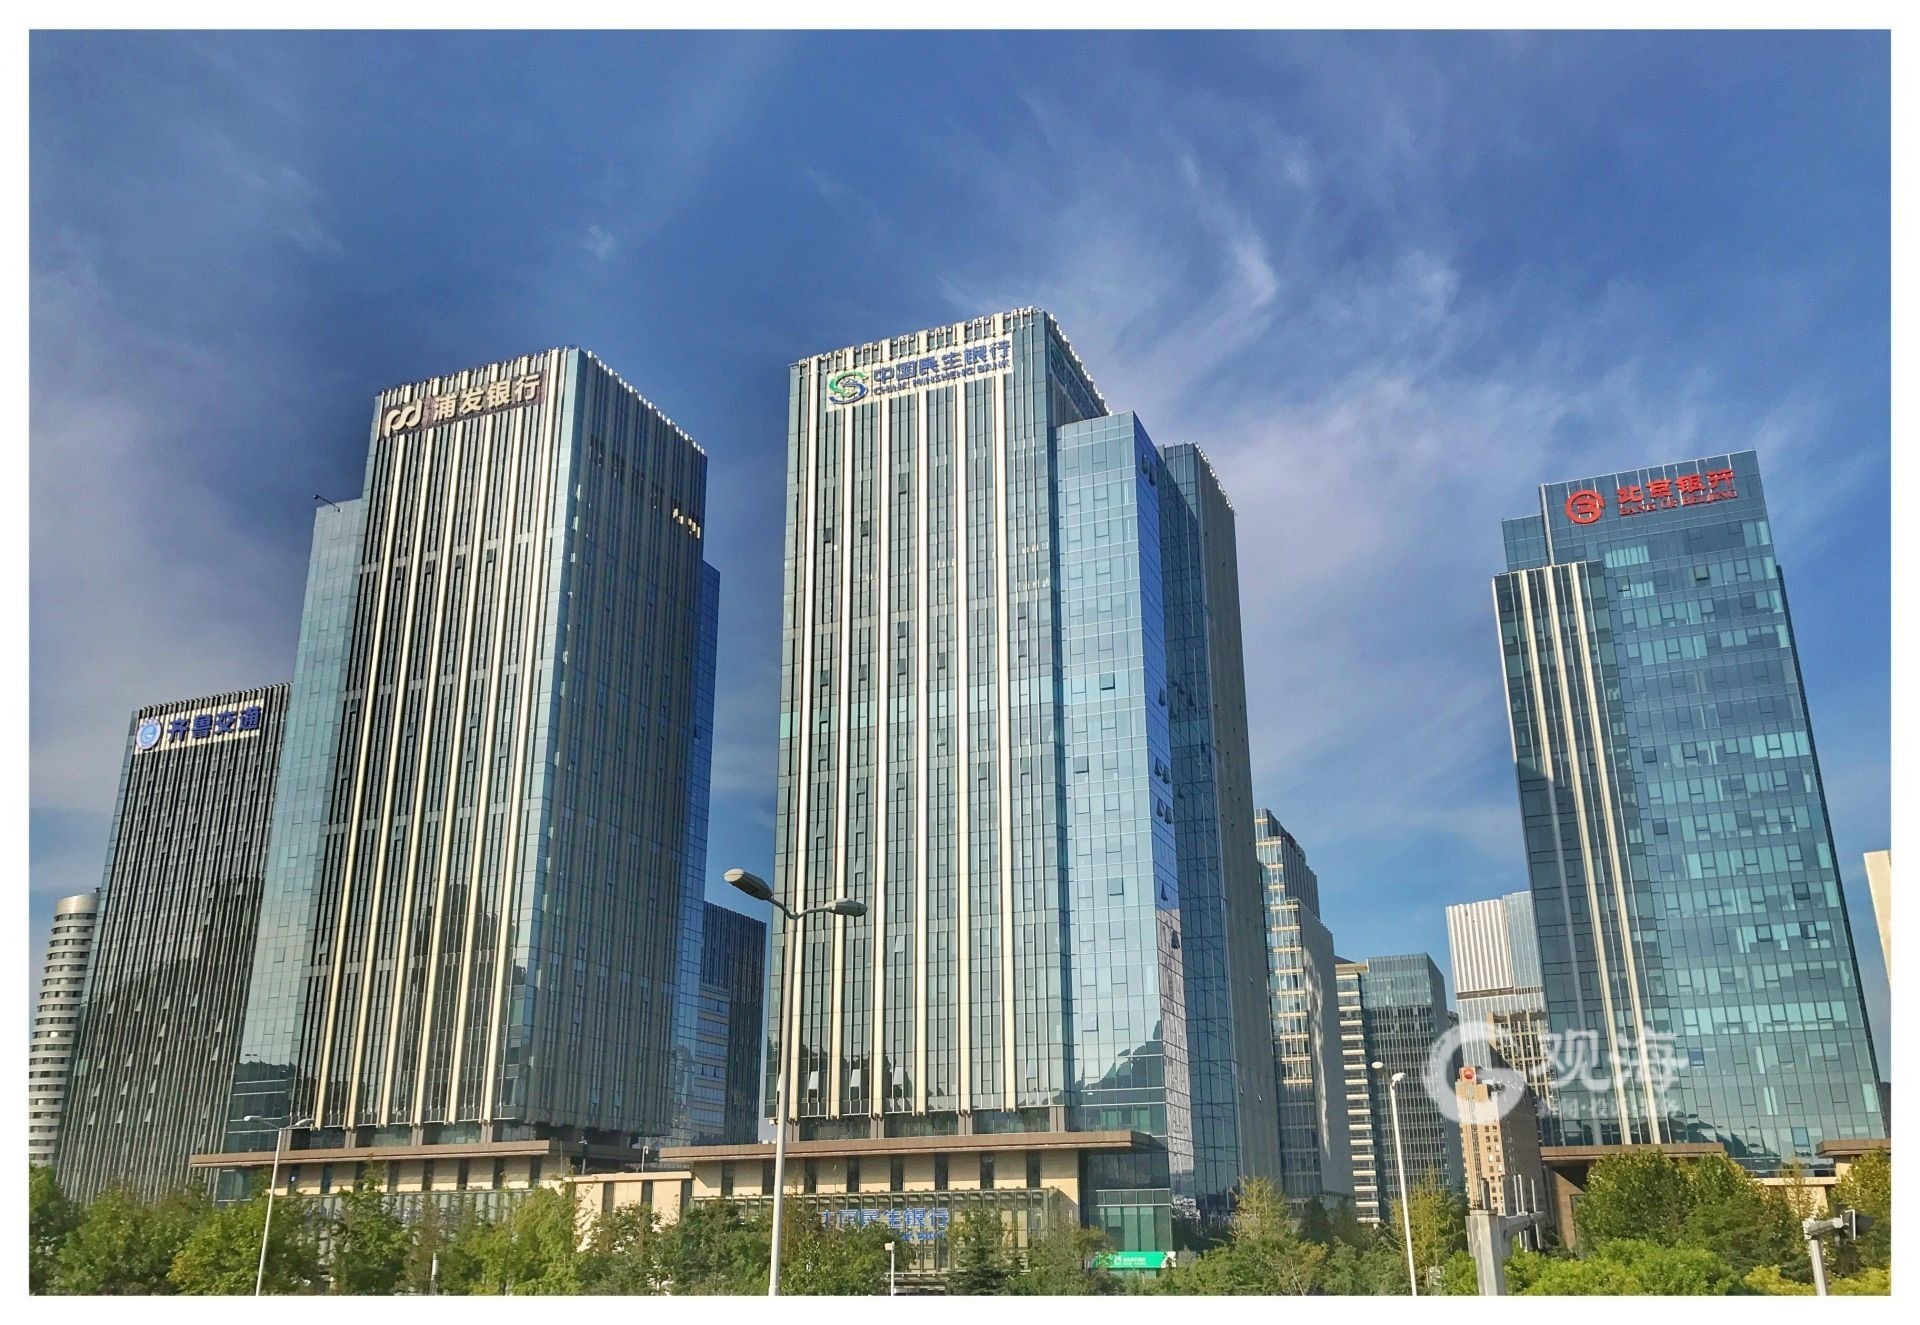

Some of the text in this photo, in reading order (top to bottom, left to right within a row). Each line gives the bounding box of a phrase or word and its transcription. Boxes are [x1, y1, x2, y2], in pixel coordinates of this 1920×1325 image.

[873, 340, 1011, 384] 中国民生银行
[433, 374, 540, 421] 浦发银行
[1617, 469, 1735, 504] 北京银行
[167, 705, 262, 743] 齐鲁交通
